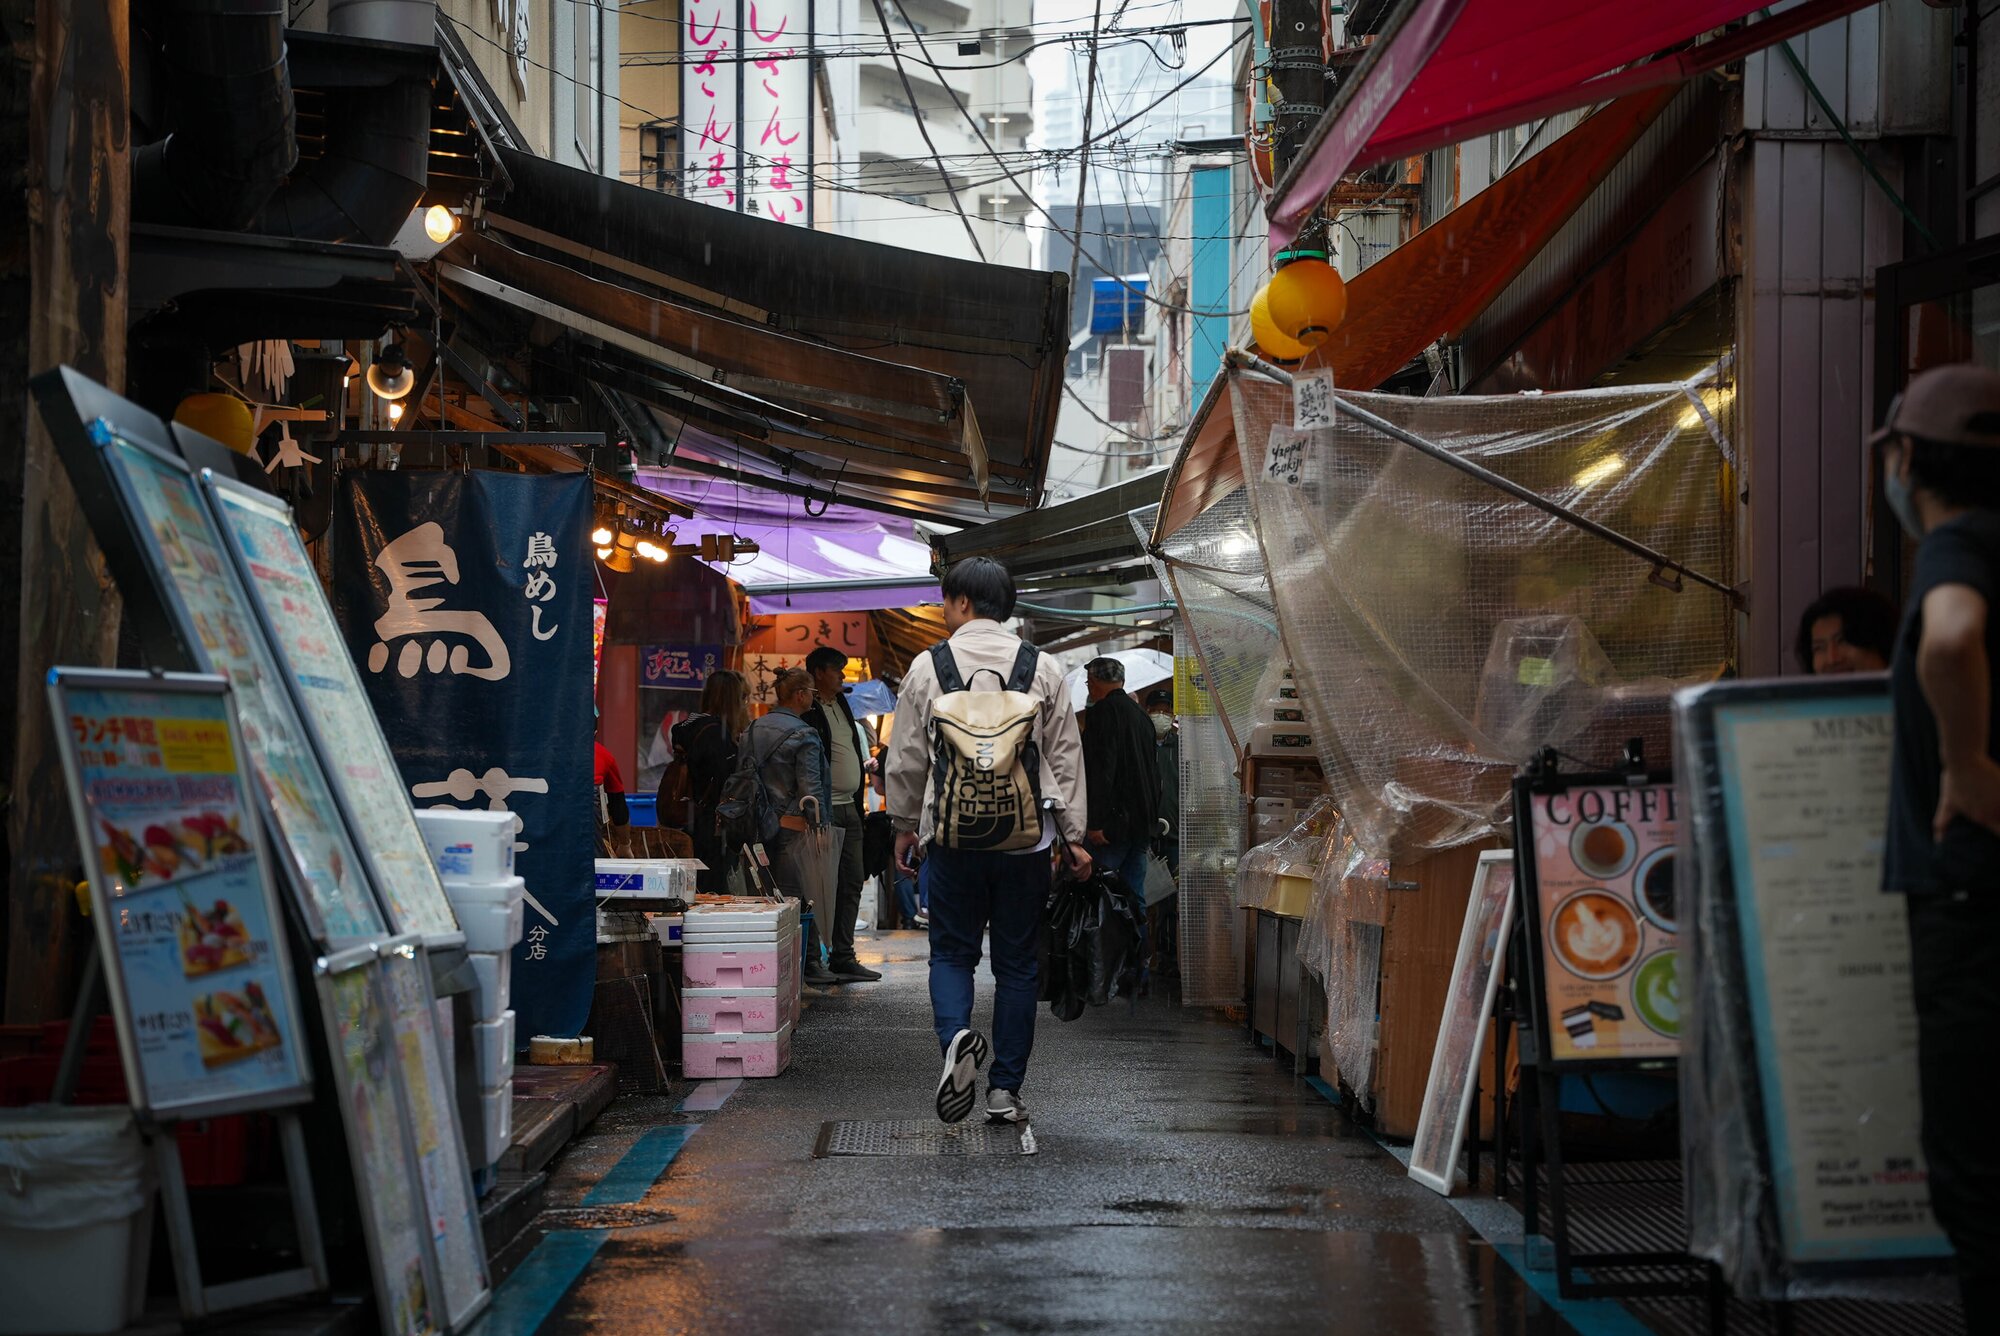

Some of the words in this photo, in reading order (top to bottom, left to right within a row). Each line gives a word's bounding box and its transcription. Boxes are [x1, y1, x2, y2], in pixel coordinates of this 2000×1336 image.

[690, 0, 734, 205] しざんま
[524, 532, 558, 641] 鳥めし
[785, 618, 861, 647] つきじ
[959, 758, 978, 815] FACE
[976, 742, 996, 815] NORTH
[995, 768, 1015, 814] THE
[525, 925, 548, 961] 分店
